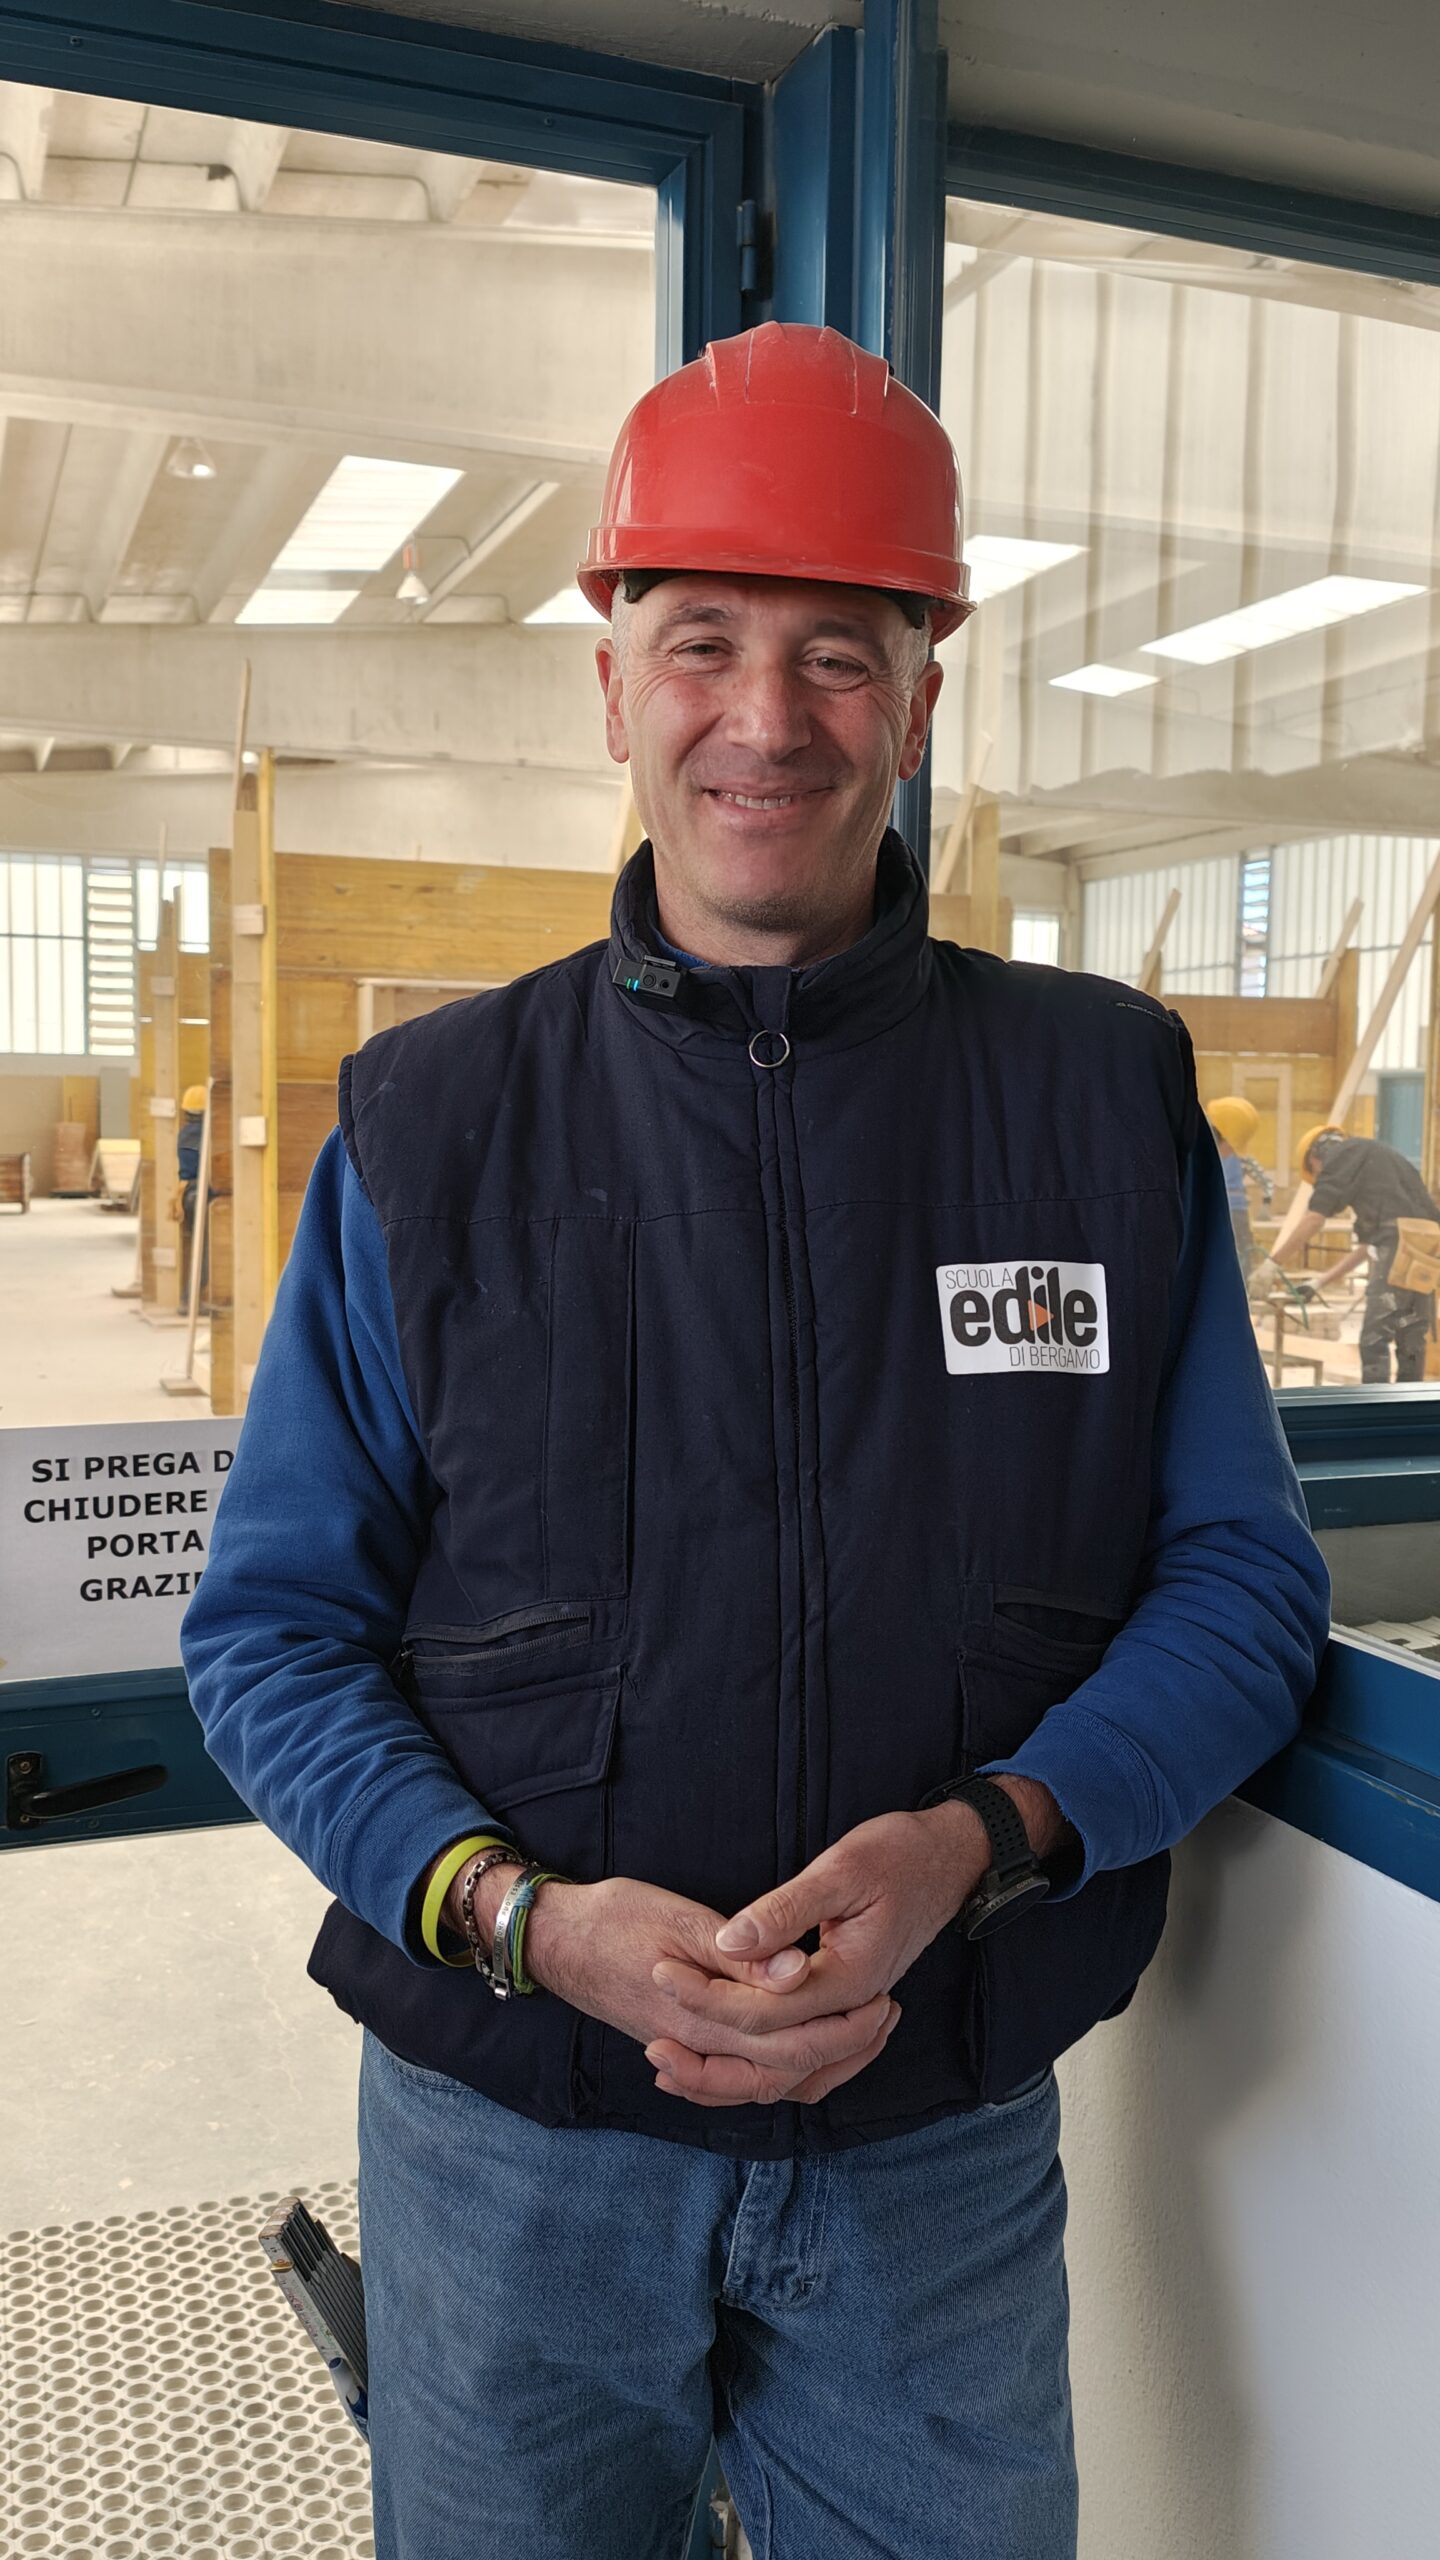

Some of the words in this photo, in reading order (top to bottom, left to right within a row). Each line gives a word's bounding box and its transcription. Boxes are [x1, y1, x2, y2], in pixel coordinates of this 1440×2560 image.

[945, 1267, 1015, 1290] SCUOLA
[950, 1265, 1098, 1347] edile
[1009, 1346, 1025, 1367] DI
[1029, 1346, 1101, 1370] BERGAMO
[31, 1458, 70, 1483] SI
[84, 1451, 201, 1480] PREGA
[213, 1450, 235, 1472] D
[23, 1490, 208, 1523] CHIUDERE
[87, 1529, 204, 1559] PORTA
